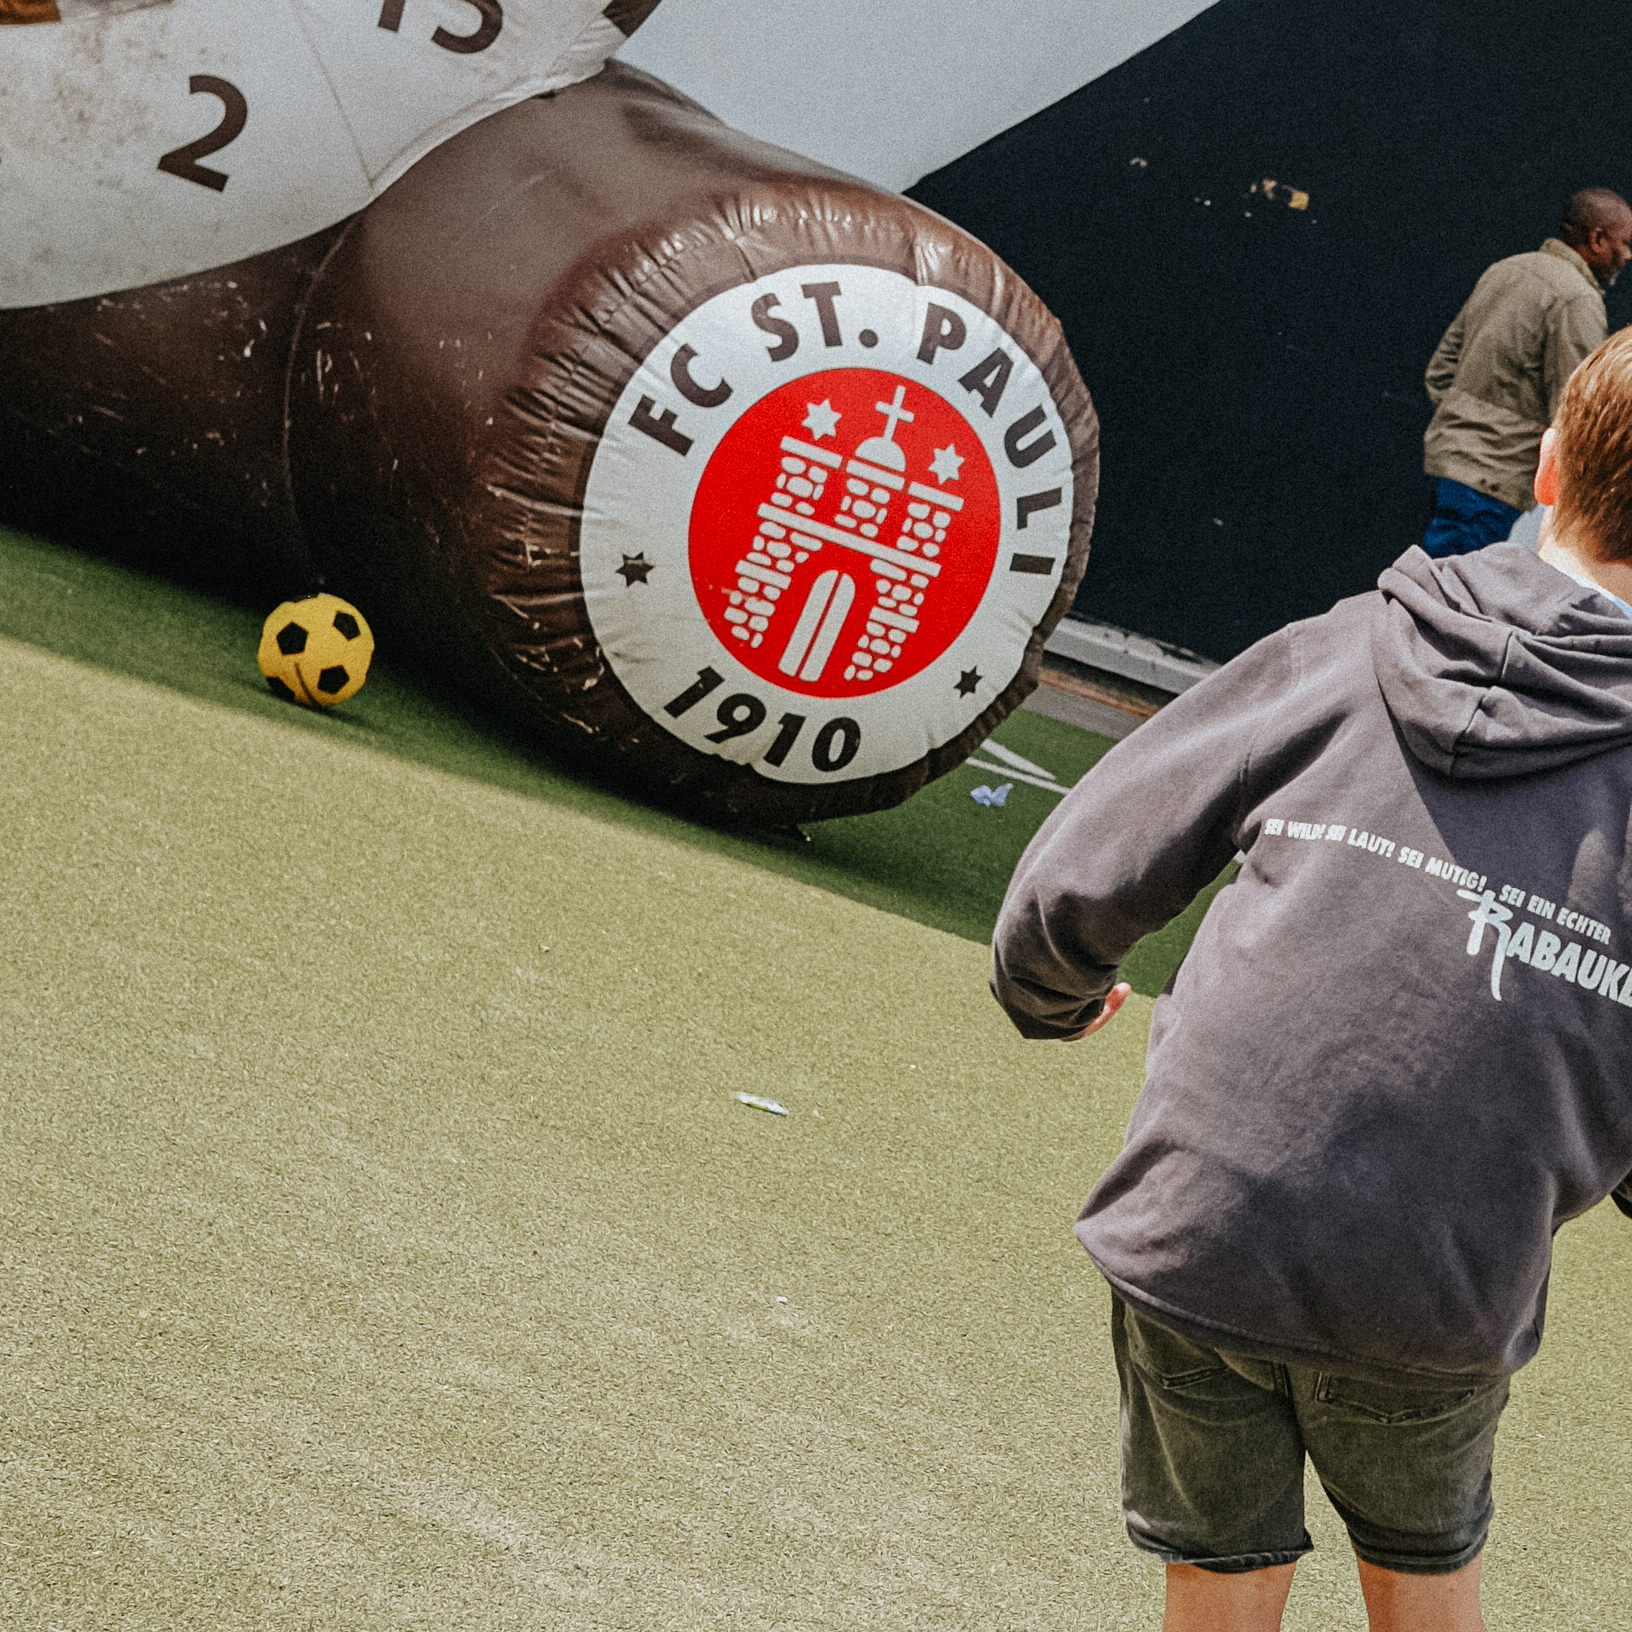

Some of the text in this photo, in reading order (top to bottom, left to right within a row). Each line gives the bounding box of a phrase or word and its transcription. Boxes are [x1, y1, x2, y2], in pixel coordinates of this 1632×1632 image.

[157, 74, 248, 193] 2
[628, 281, 1063, 576] FC ST. PAULI
[663, 666, 861, 772] 1910
[1347, 828, 1396, 858] LAUT!
[1398, 846, 1425, 869] SEI
[1425, 856, 1488, 892] MUTIG!
[1499, 884, 1526, 908] SEI
[1527, 894, 1556, 920] EIN
[1556, 907, 1612, 945] ECHTER
